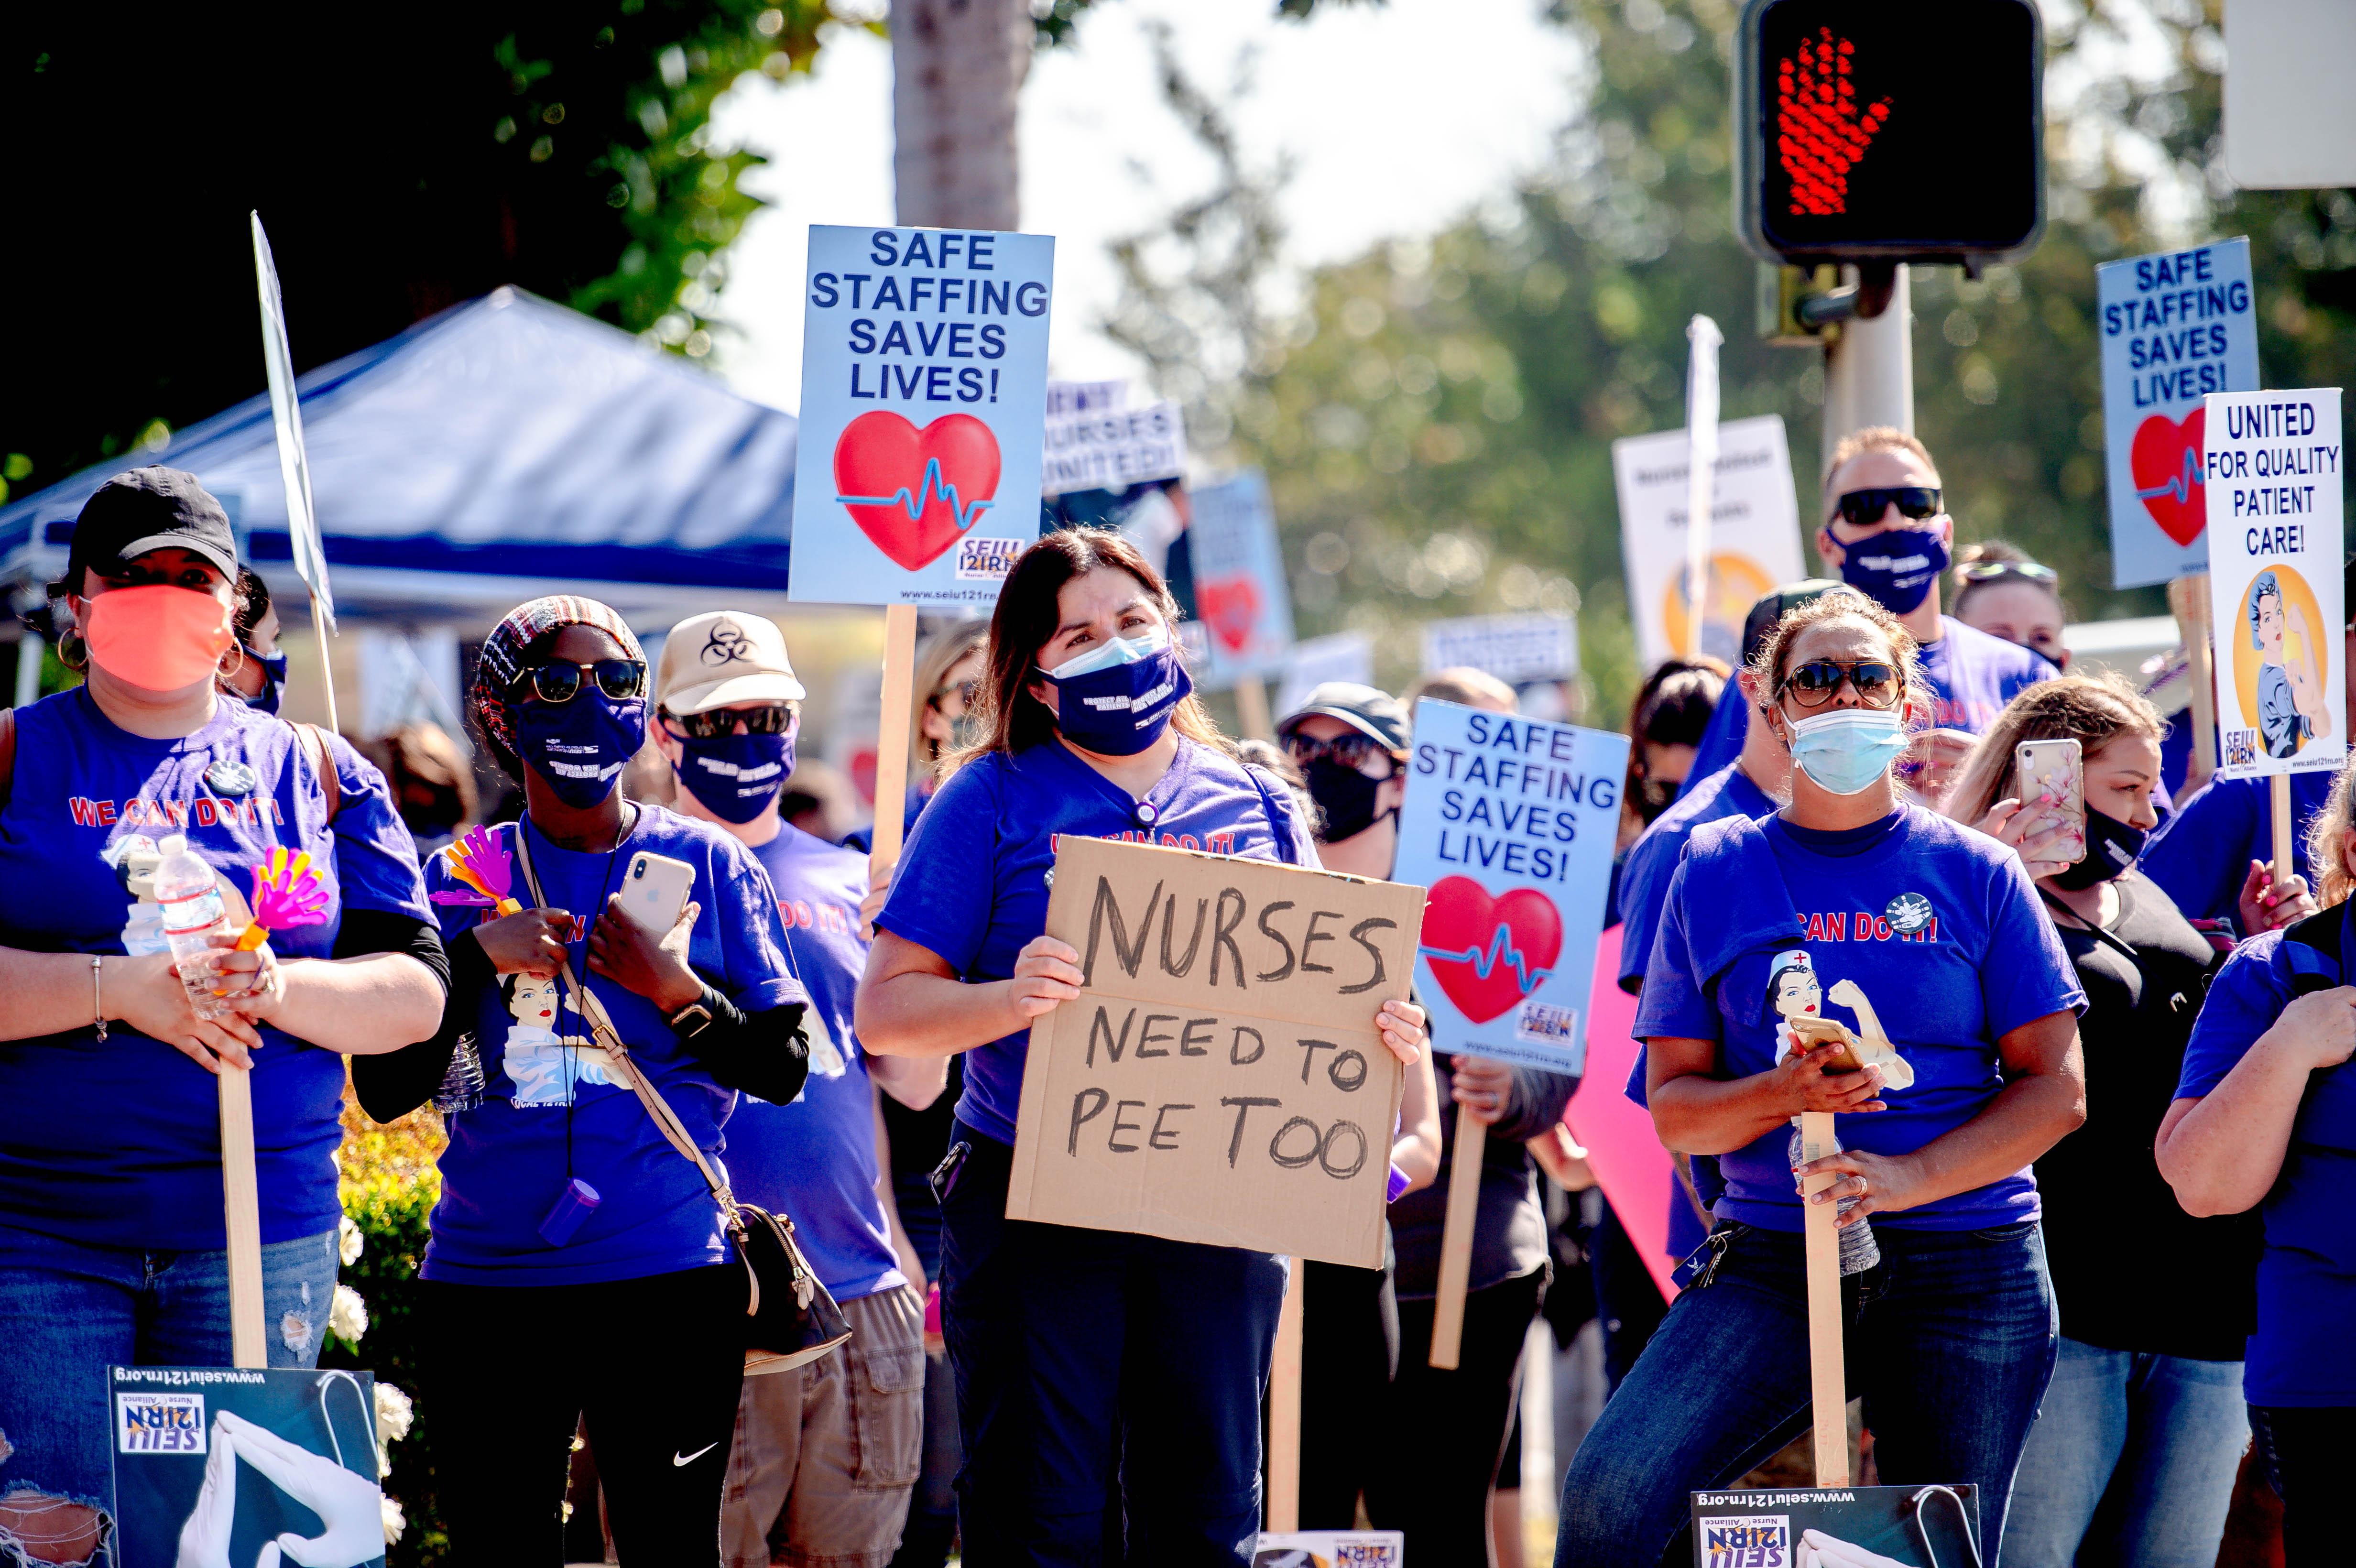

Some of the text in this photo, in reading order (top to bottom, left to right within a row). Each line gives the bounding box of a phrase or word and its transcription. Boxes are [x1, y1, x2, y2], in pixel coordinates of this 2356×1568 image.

[871, 231, 995, 271] SAFE
[2137, 248, 2214, 292] SAFE
[811, 272, 1047, 316] STAFFING
[2105, 281, 2249, 336] STAFFING
[849, 318, 1006, 359] SAVES
[2129, 324, 2228, 369] SAVES
[850, 363, 999, 403] LIVES!
[2133, 364, 2227, 408] LIVES!
[1046, 412, 1170, 448] URSES
[2227, 403, 2316, 439] UNITED
[2208, 445, 2340, 479] FOR QUALITY
[2234, 486, 2315, 518] PATIENT
[965, 540, 1019, 555] SEIU
[2247, 524, 2305, 556] CARE!
[900, 588, 997, 600] www.seiu121rn
[1083, 697, 1114, 705] PROTECT
[1096, 702, 1130, 711] PATIENTS
[1132, 688, 1156, 706] PROTECT
[1134, 684, 1174, 713] HCA WORKERS
[1466, 714, 1576, 762] SAFE
[2226, 730, 2256, 748] SEIU
[1416, 744, 1615, 810] STAFFING
[2292, 757, 2344, 768] www.seiu121rn.org
[69, 796, 285, 828] WE CAN DO IT!
[1441, 791, 1577, 843] SAVES
[1440, 830, 1568, 882] LIVES!
[778, 899, 813, 929] DO
[1854, 912, 1893, 941] DO
[1082, 874, 1398, 995] NURSES
[1086, 1005, 1368, 1093] NEED TO
[1068, 1087, 1369, 1180] PEE TOO
[116, 1367, 265, 1384] www.seiu121rn.org
[123, 1396, 192, 1405] Nurse Alliance
[128, 1427, 198, 1450] SEIU
[1698, 1492, 1855, 1507] www.seiu121rn.org
[1711, 1545, 1785, 1568] SEIU
